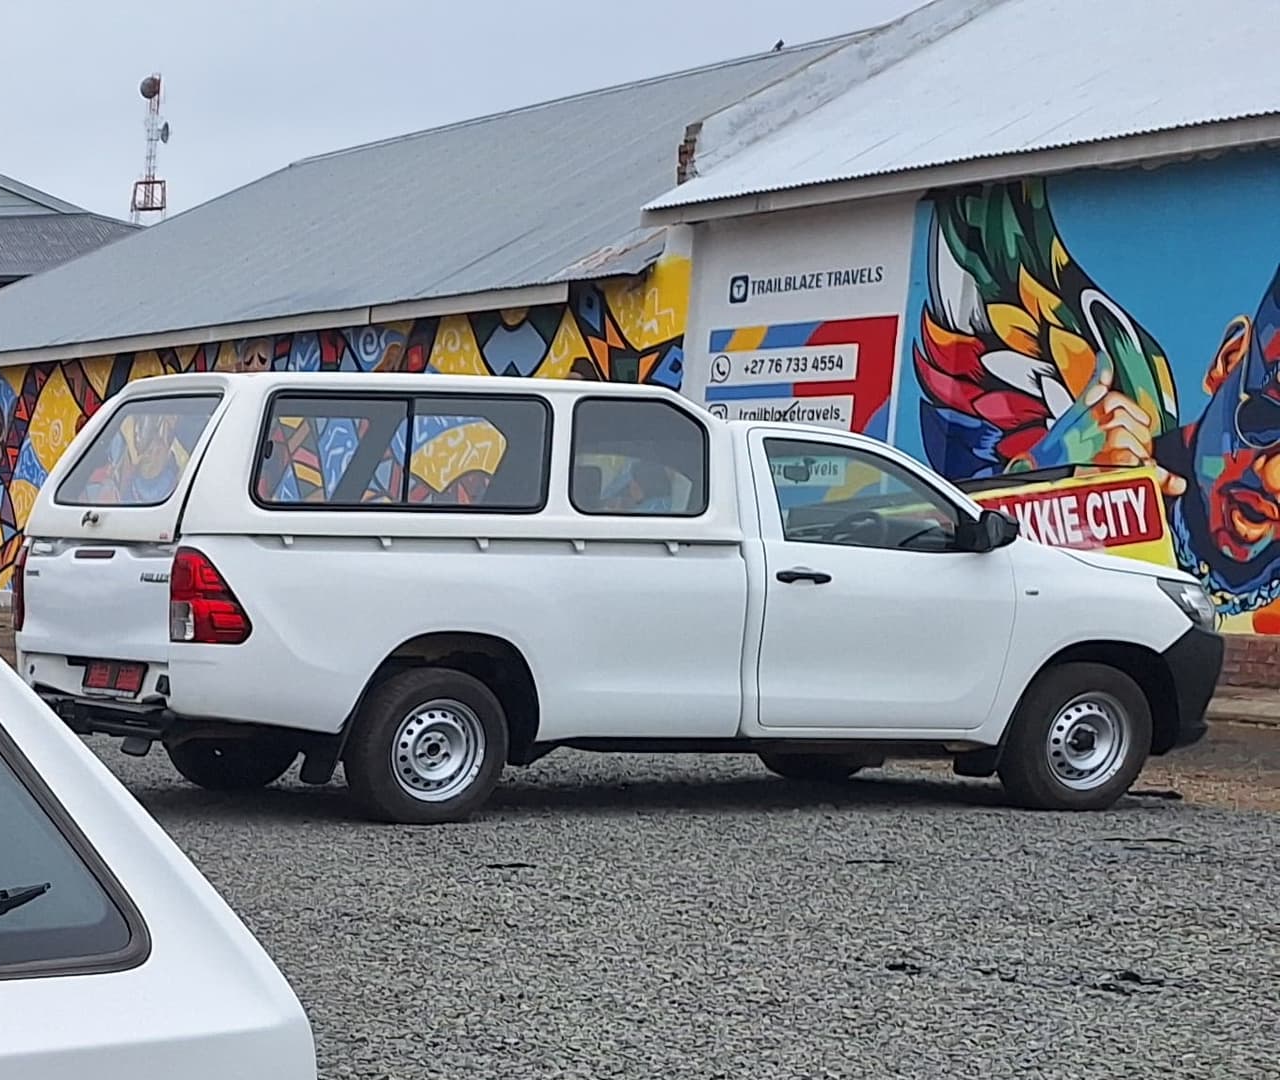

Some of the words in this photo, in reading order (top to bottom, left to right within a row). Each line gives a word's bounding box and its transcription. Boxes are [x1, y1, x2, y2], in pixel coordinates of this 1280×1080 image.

[751, 272, 824, 296] TRAILBLAZE
[826, 266, 884, 288] TRAVELS
[744, 359, 765, 375] +27
[768, 358, 783, 374] 76
[785, 356, 808, 373] 733
[811, 354, 844, 371] 4554
[1086, 486, 1148, 541] CITY
